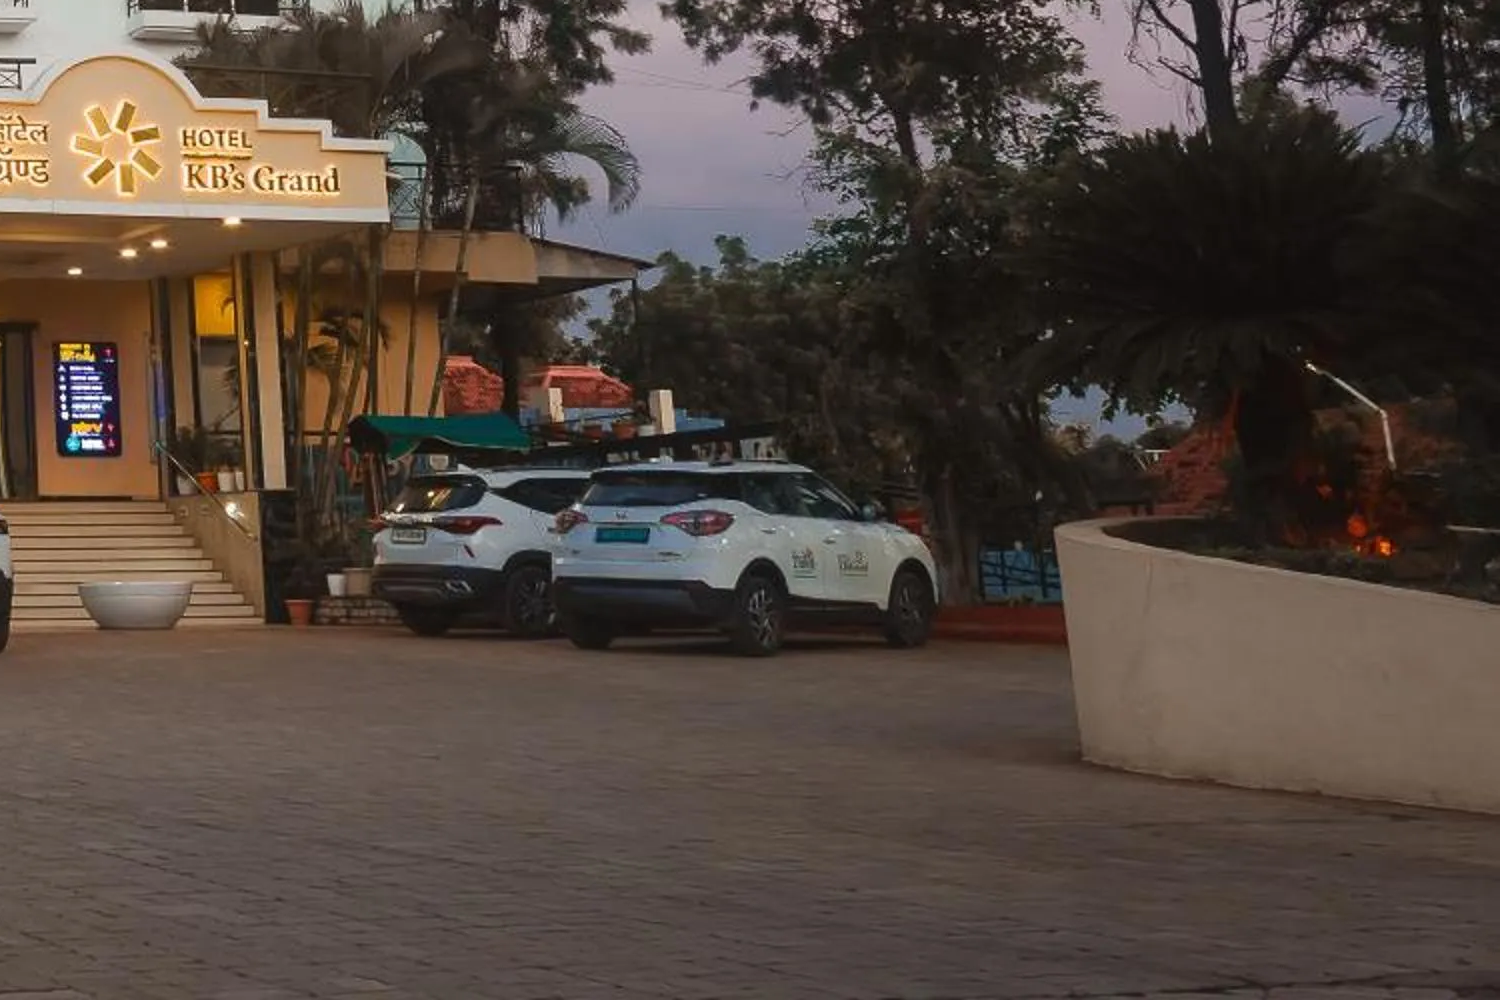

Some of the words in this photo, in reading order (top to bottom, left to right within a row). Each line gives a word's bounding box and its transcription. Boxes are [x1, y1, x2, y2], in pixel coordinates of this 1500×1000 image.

[182, 129, 253, 149] HOTEL
[184, 163, 245, 190] KB's
[253, 165, 341, 193] Grand
